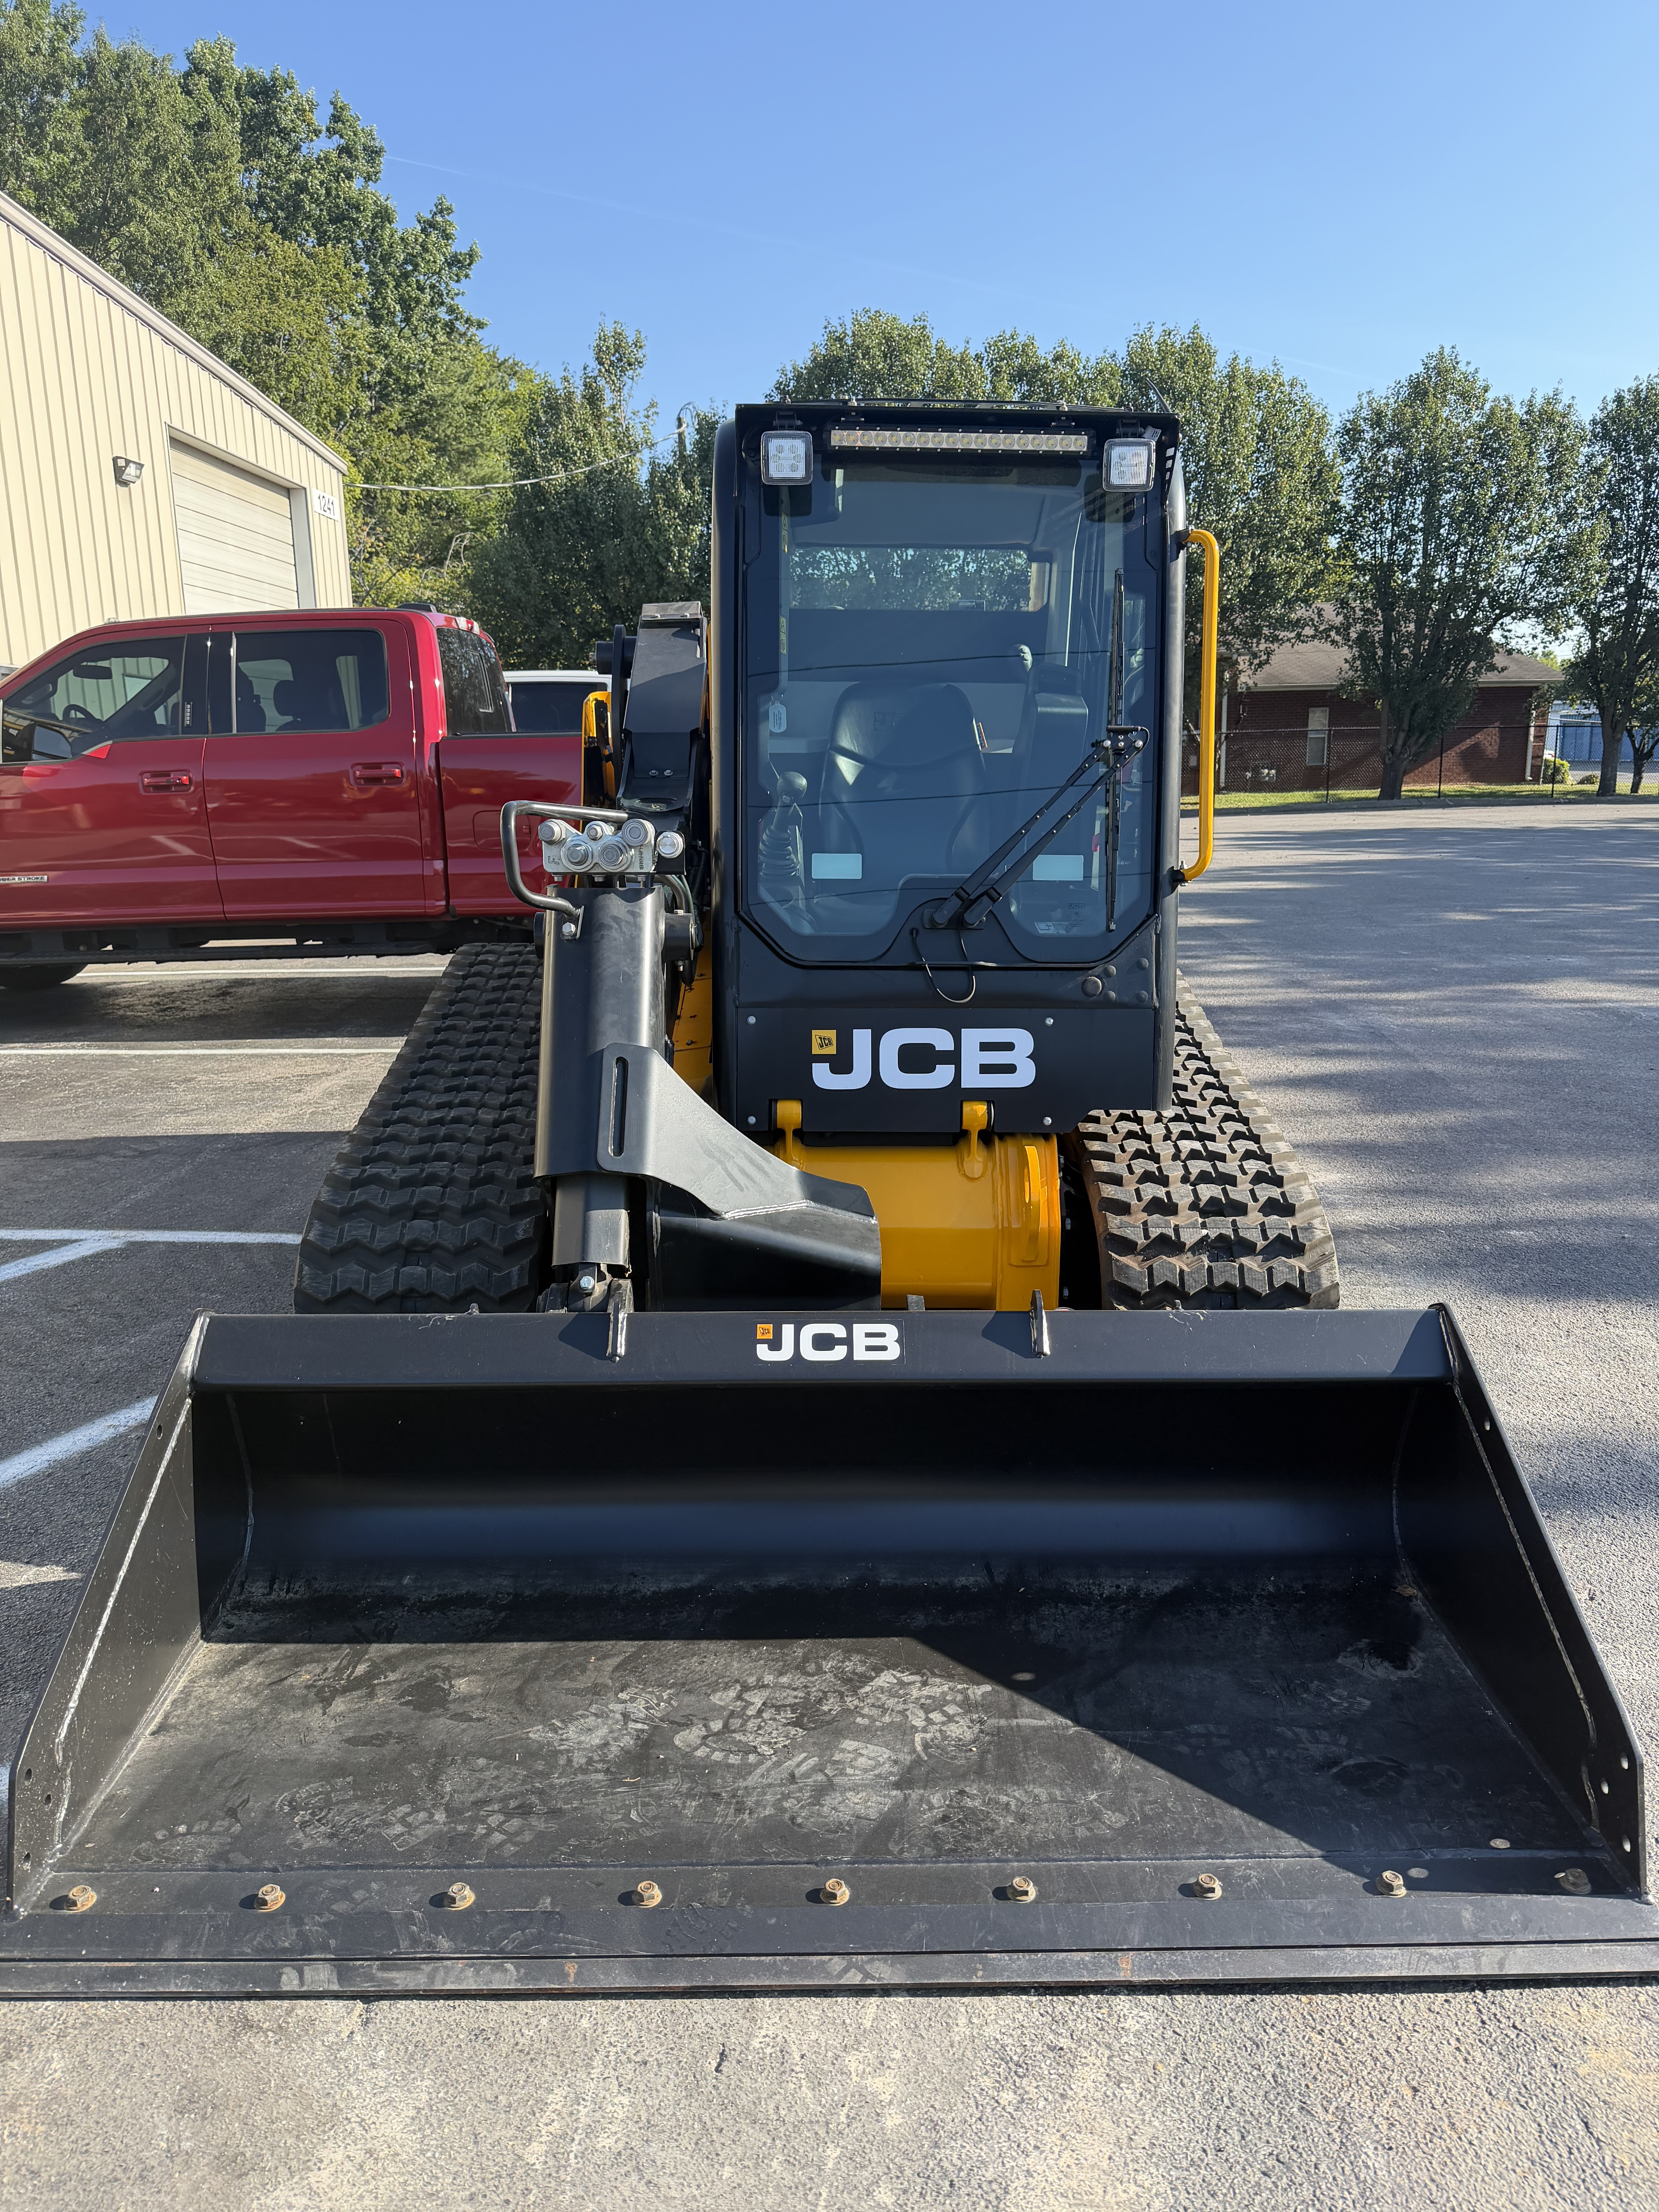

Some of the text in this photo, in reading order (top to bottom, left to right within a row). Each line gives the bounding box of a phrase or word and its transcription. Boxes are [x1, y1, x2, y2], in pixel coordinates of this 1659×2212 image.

[318, 494, 335, 516] 1241
[818, 1036, 832, 1048] JCB
[812, 1027, 1036, 1090] JCB
[756, 1323, 900, 1361] JCB
